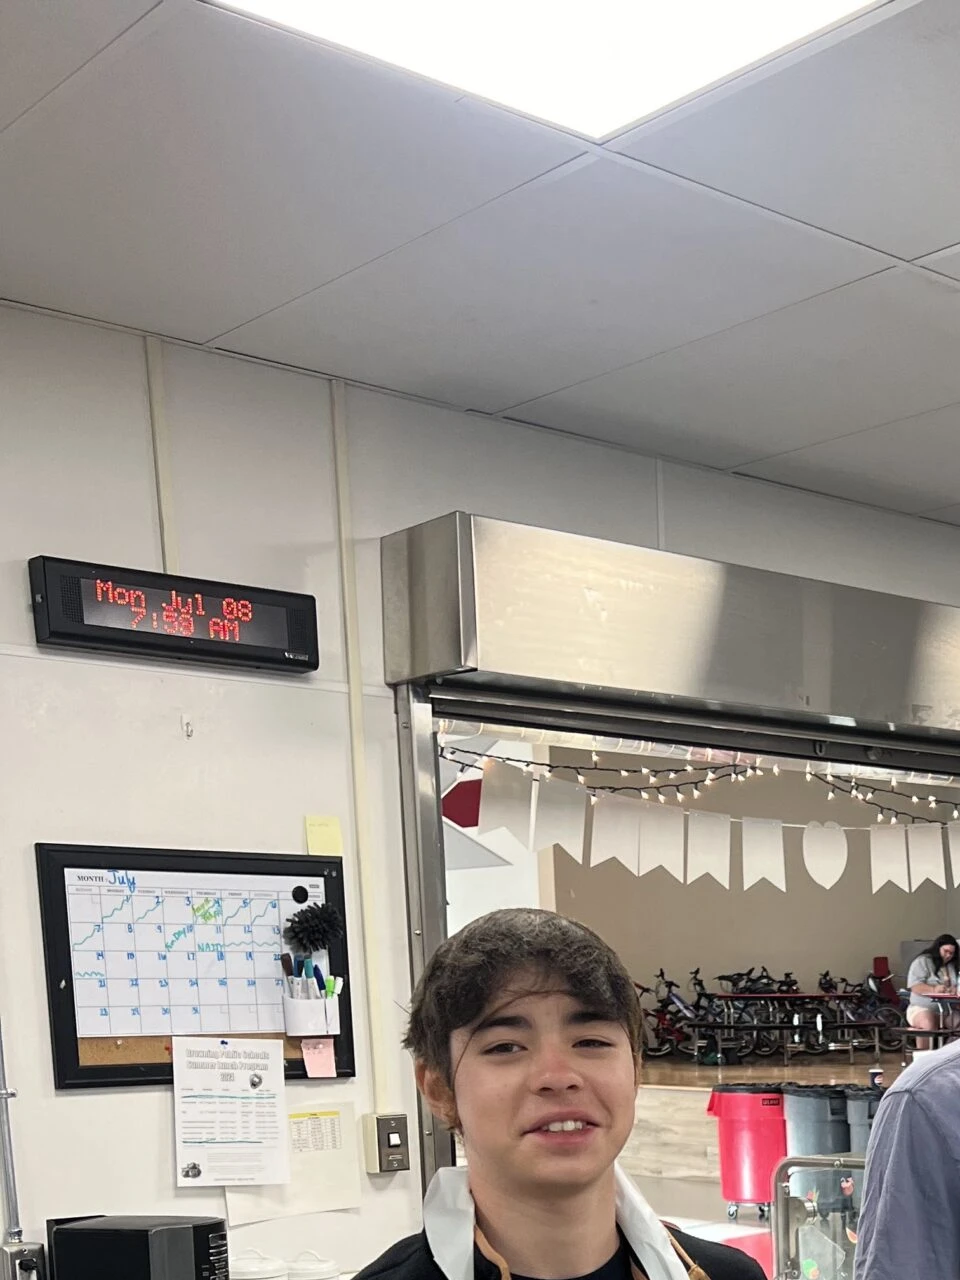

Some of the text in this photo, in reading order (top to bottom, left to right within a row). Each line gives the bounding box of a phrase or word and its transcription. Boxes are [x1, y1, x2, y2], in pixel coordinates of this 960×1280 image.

[96, 579, 252, 621] Mon Jul 08
[209, 618, 240, 641] AM
[107, 869, 136, 893] July
